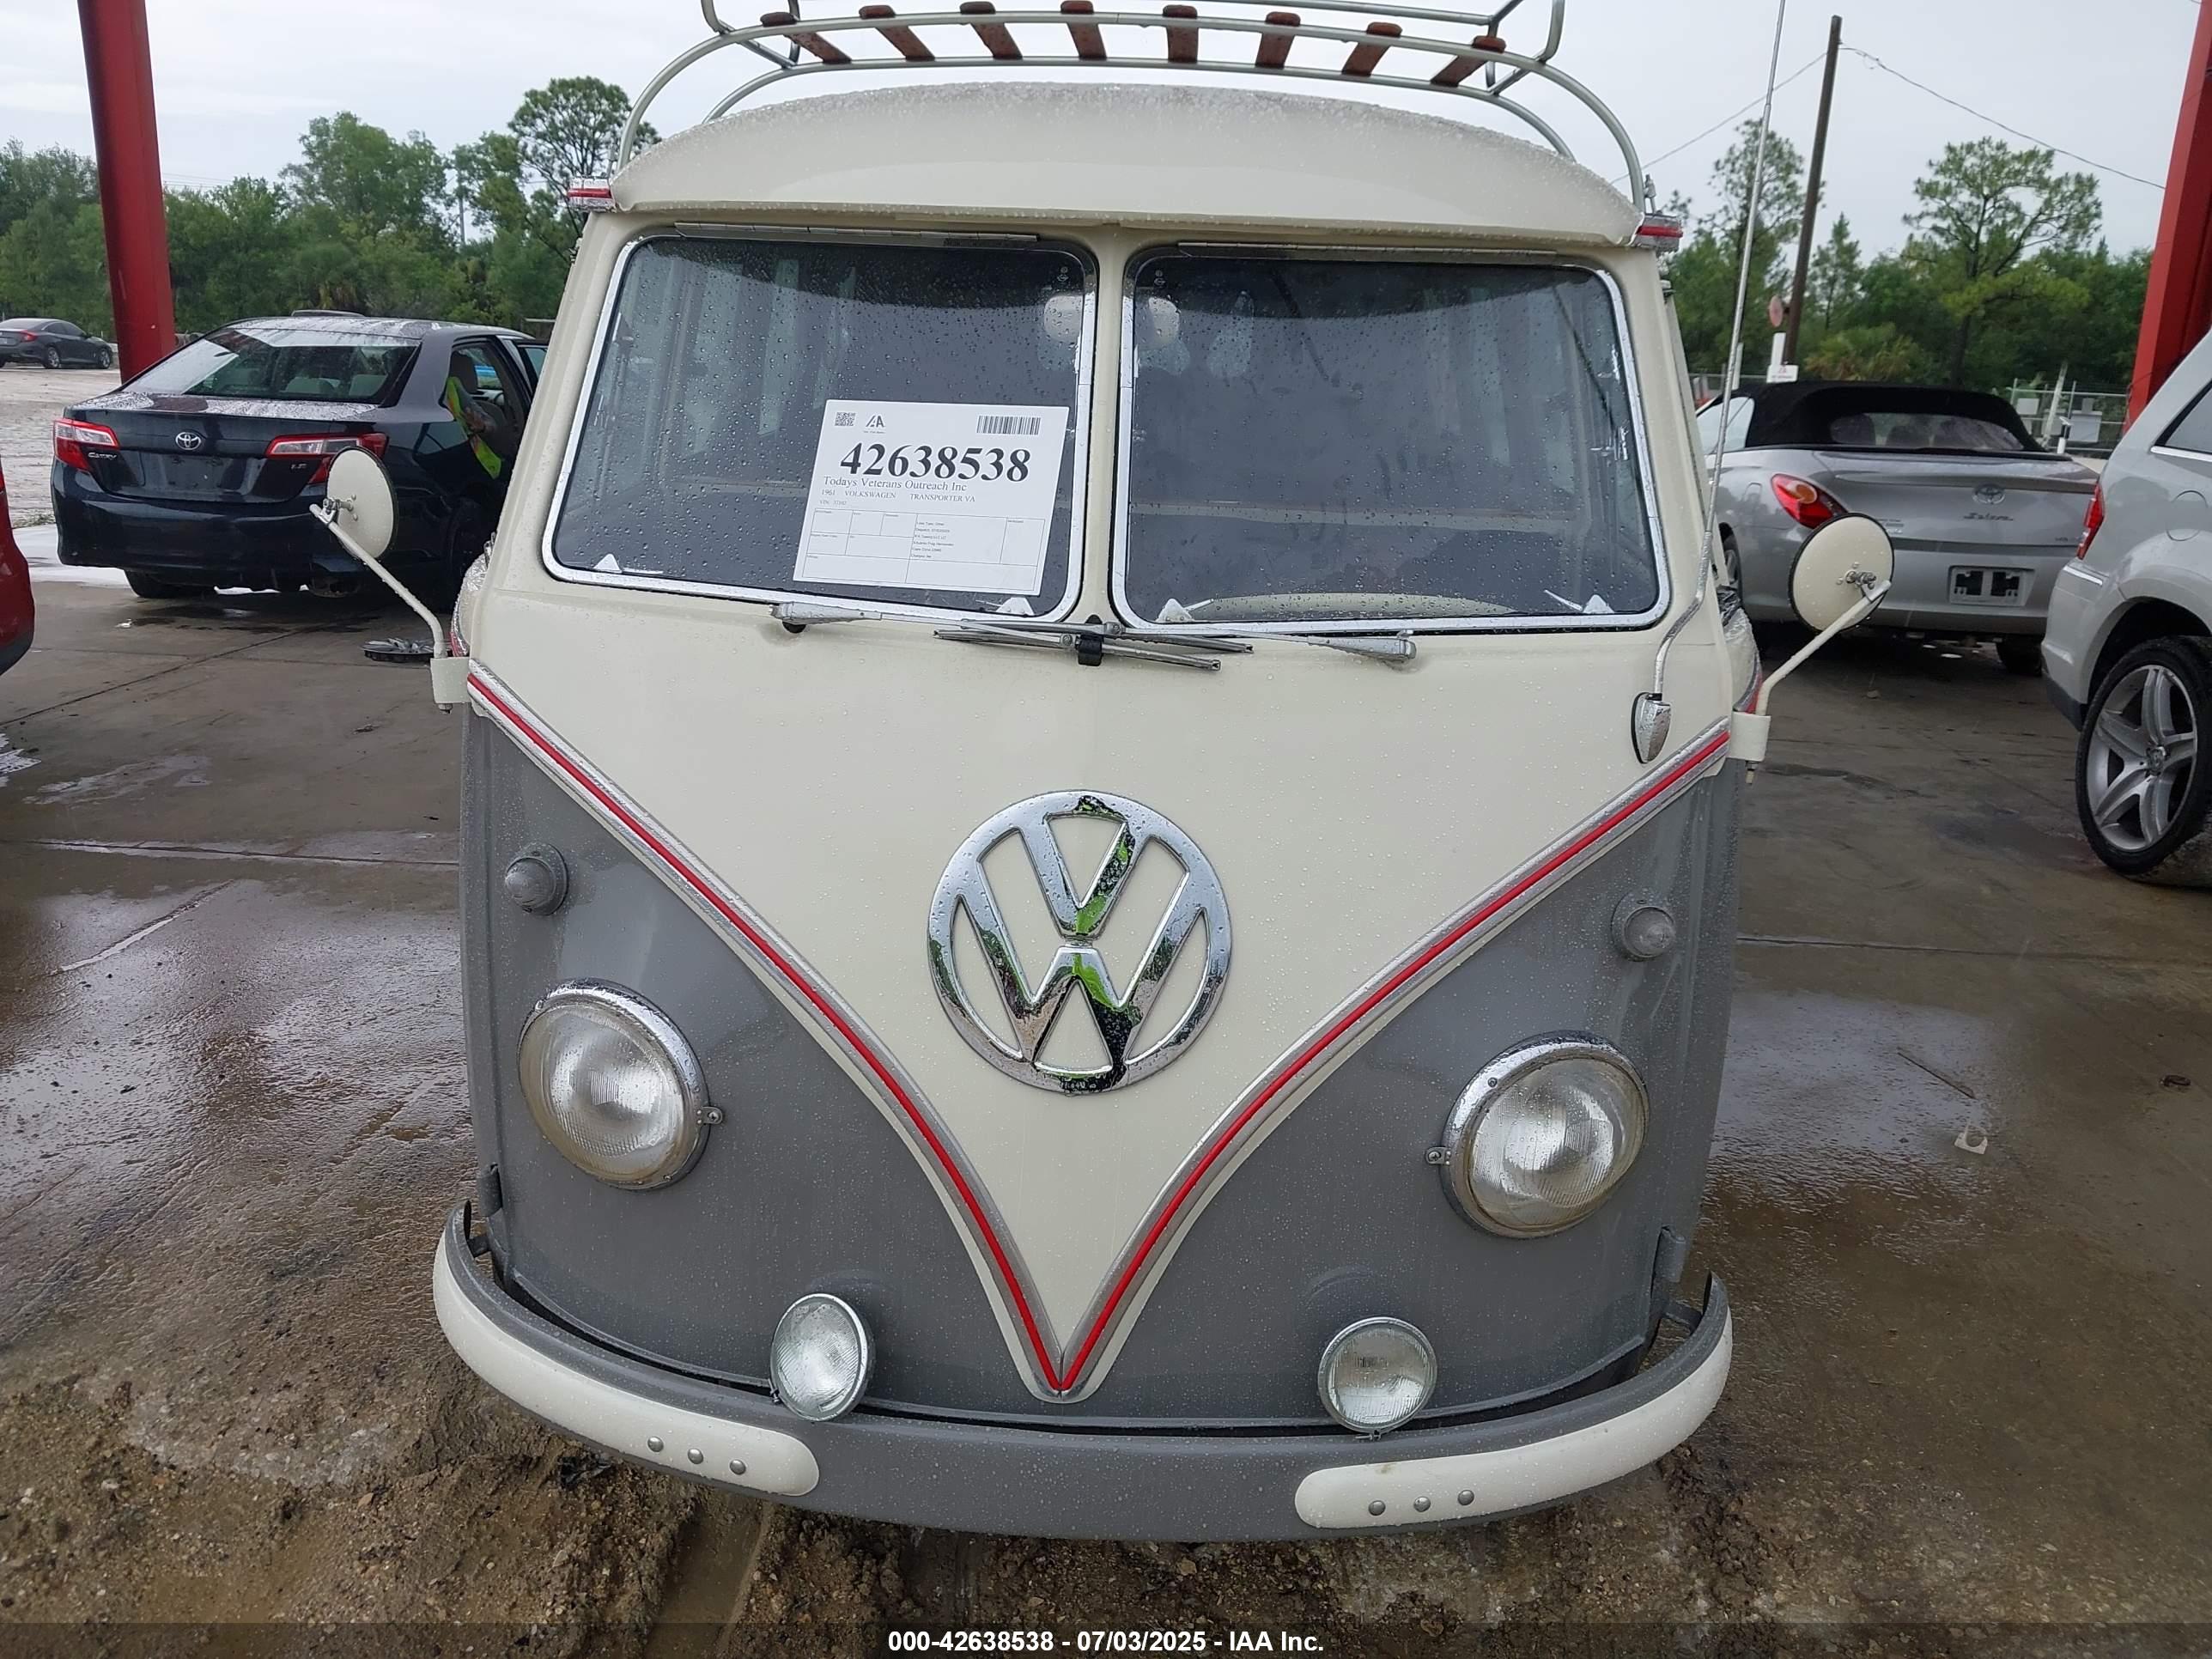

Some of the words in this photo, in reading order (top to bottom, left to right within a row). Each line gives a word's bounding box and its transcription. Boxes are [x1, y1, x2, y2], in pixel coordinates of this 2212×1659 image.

[840, 442, 1031, 483] 42638538
[823, 476, 858, 488] Todays
[860, 477, 902, 489] Veterans
[904, 480, 949, 491] Outreach
[951, 482, 968, 492] Inc
[844, 490, 896, 499] VOLKSWAGEN
[909, 493, 963, 502] TRANSPORTER
